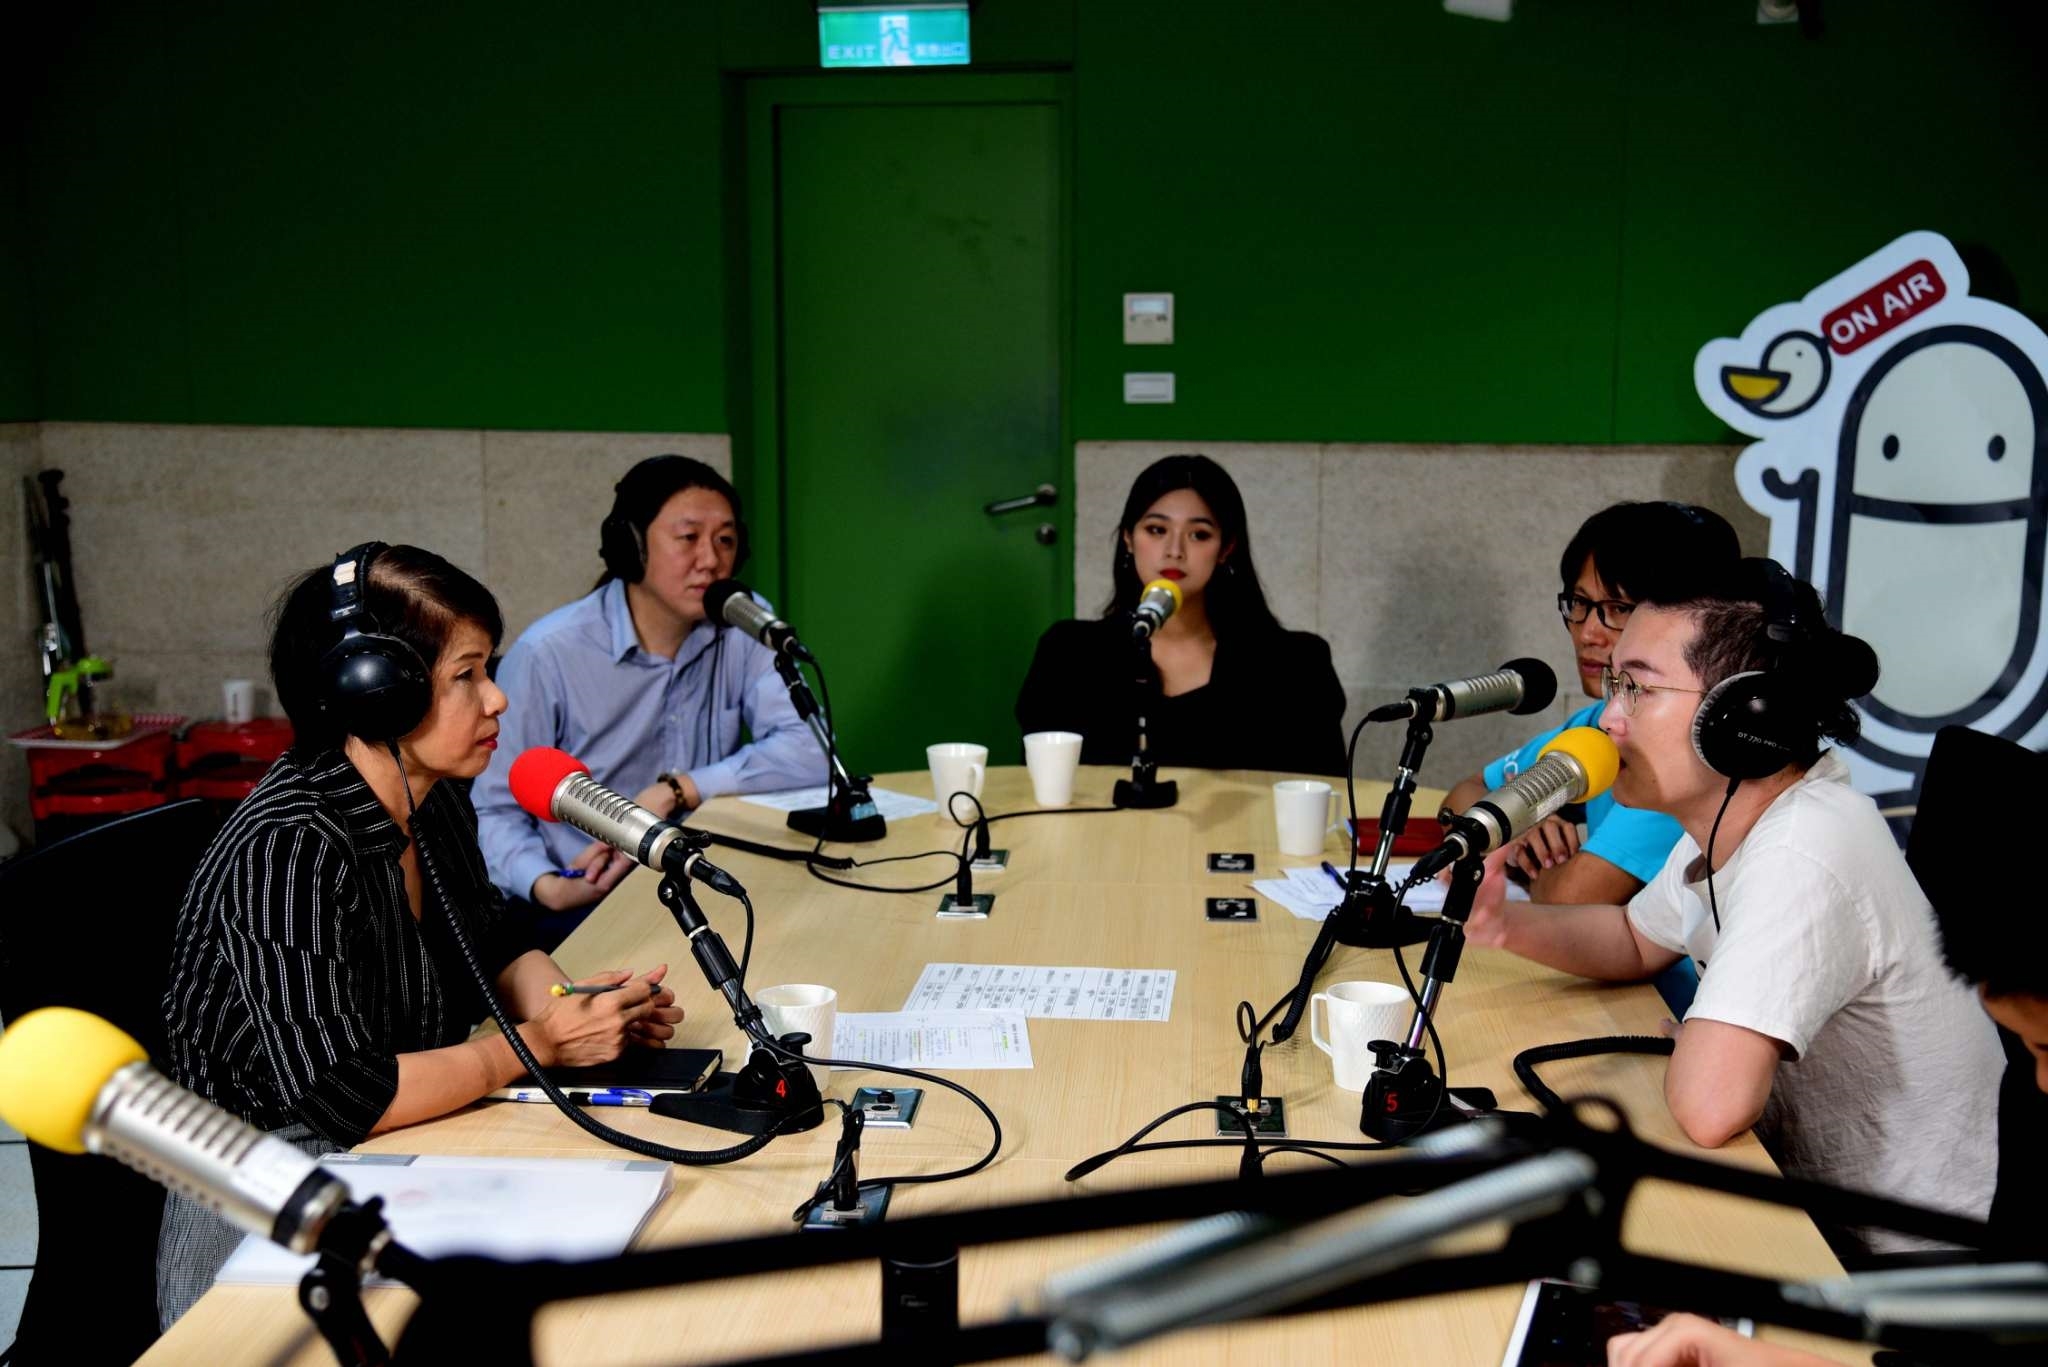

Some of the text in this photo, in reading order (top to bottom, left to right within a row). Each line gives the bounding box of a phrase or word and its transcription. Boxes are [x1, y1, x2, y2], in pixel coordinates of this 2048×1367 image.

[828, 44, 876, 59] EXIT
[1831, 272, 1935, 345] ON AIR
[1748, 735, 1763, 744] 770
[1366, 906, 1374, 920] 7
[775, 1079, 787, 1098] 4
[1386, 1093, 1399, 1114] 5
